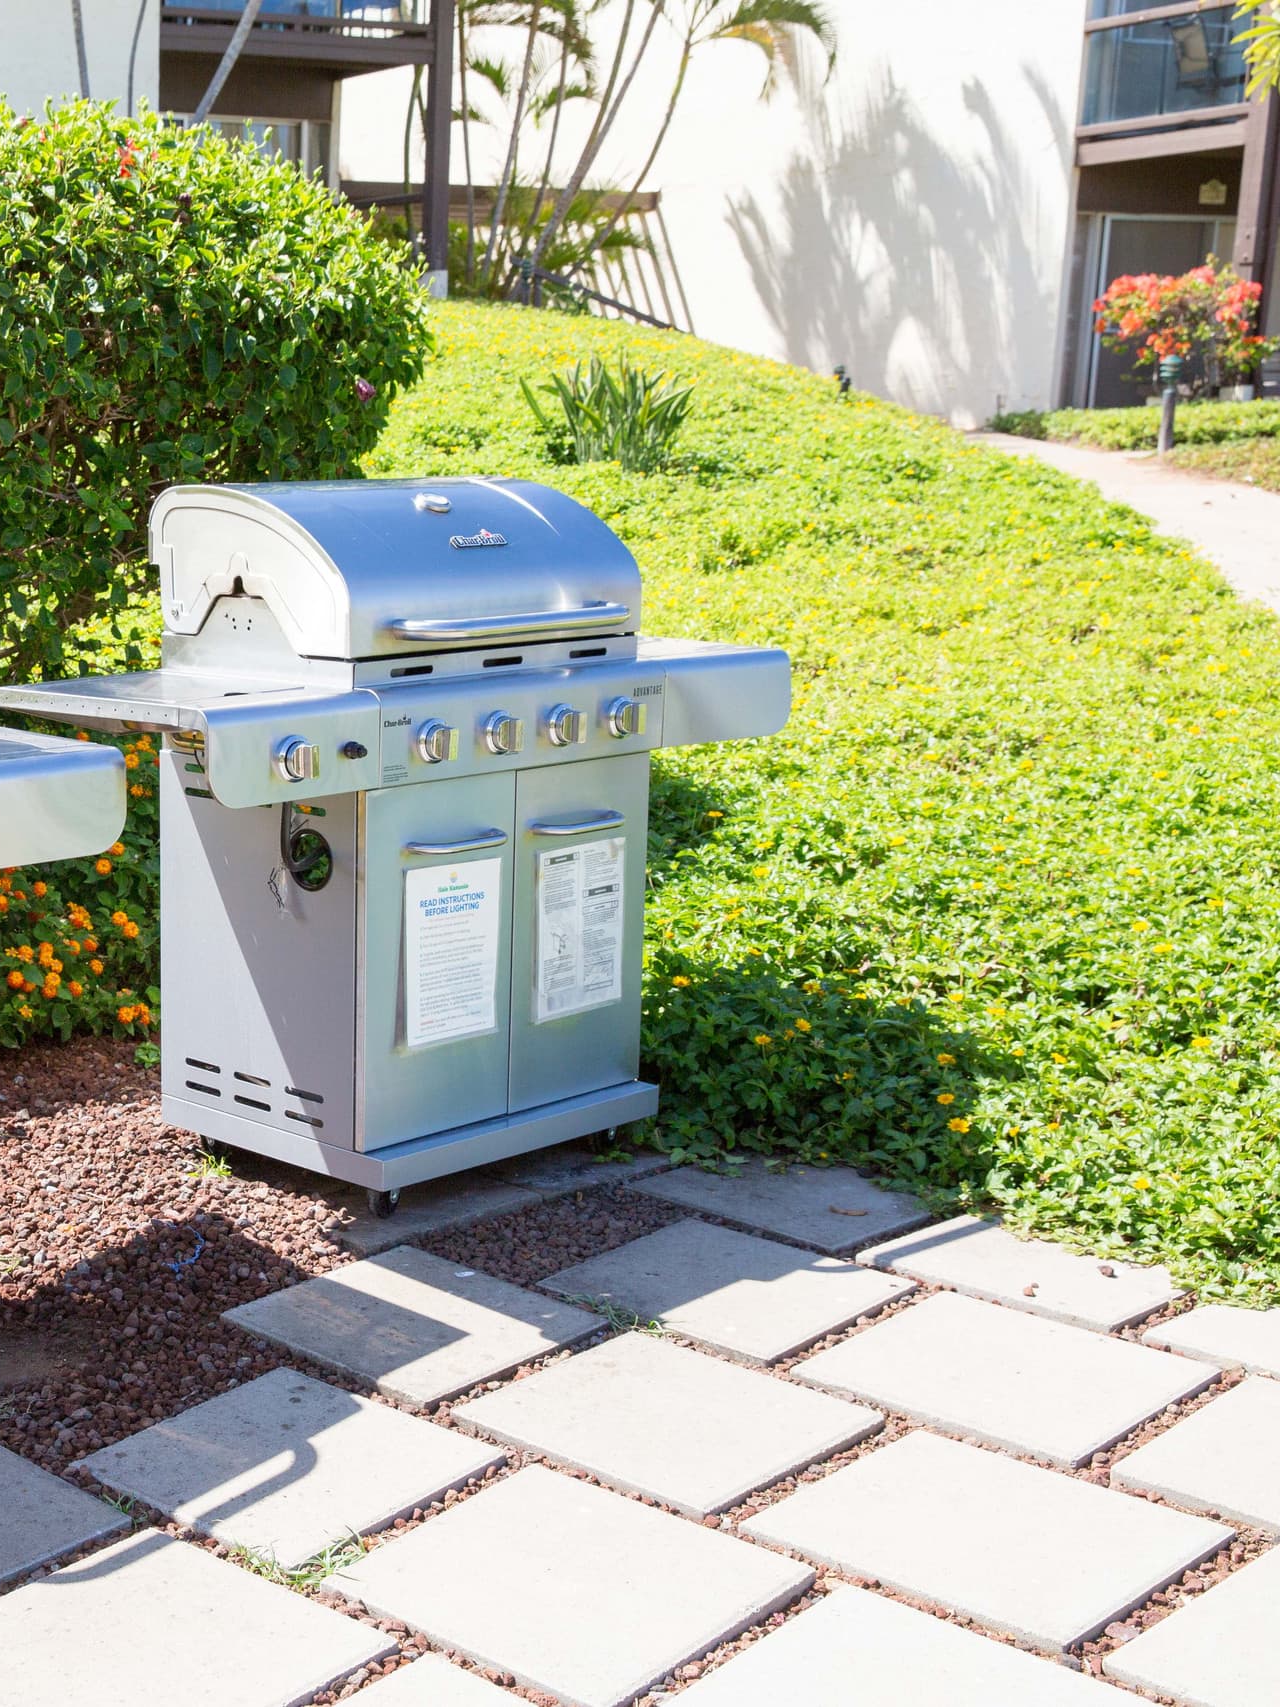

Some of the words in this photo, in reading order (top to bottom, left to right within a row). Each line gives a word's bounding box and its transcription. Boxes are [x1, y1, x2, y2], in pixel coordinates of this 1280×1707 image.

[633, 684, 663, 697] ADVANTAGE
[419, 899, 437, 908] READ
[438, 891, 485, 905] INSTRUCTIONS
[424, 906, 449, 917] BEFORE
[449, 901, 480, 913] LIGHTING
